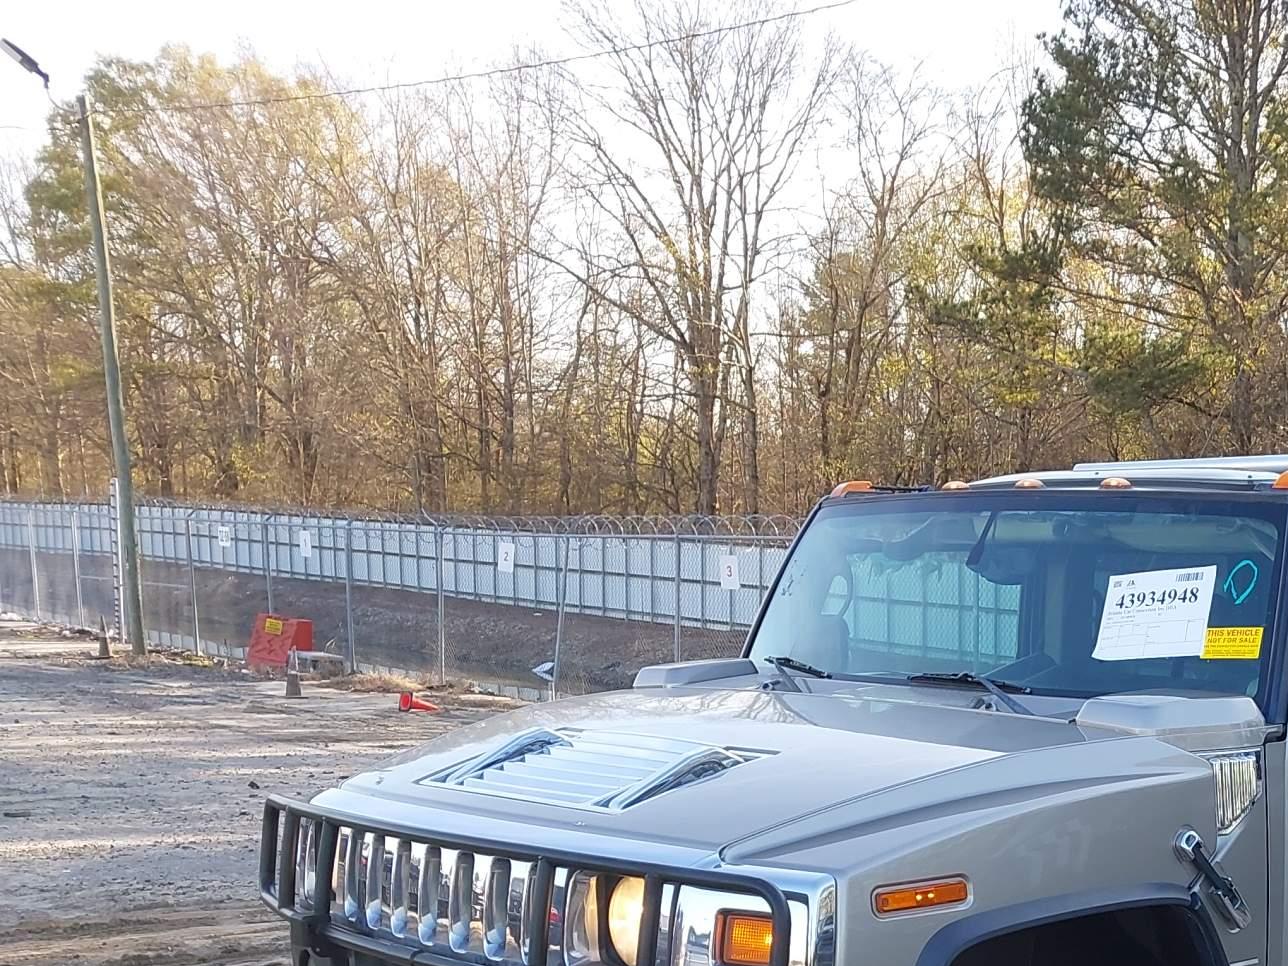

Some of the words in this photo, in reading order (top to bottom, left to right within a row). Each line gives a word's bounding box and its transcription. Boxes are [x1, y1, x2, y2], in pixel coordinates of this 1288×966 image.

[503, 551, 510, 562] 2
[726, 565, 733, 578] 3
[1115, 587, 1200, 609] 43934948
[1207, 629, 1225, 637] THIS
[1226, 628, 1260, 637] VEHICLE
